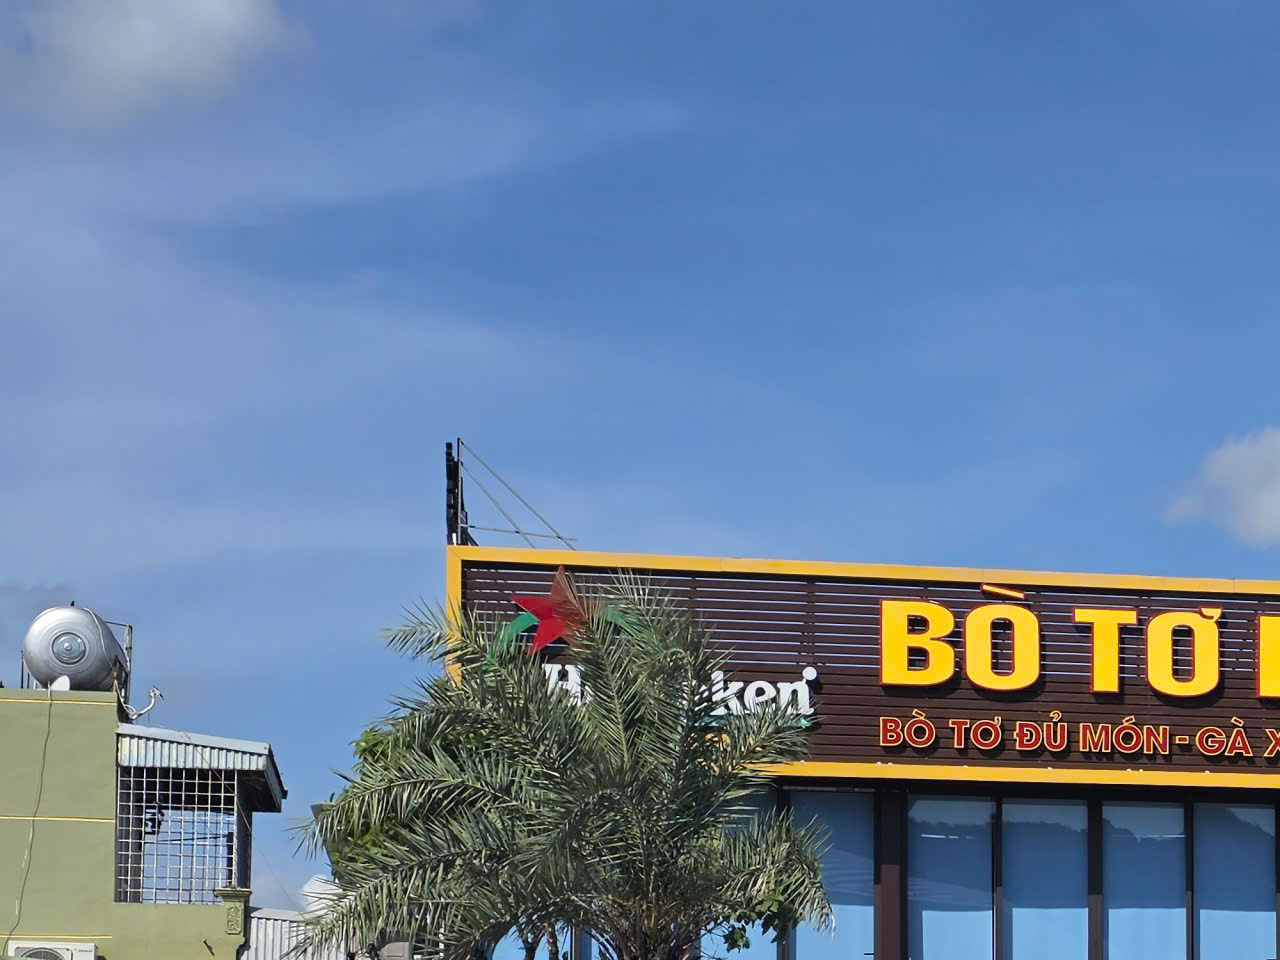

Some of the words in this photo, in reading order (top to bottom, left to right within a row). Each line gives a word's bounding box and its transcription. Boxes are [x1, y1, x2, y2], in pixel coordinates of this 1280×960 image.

[879, 583, 1041, 692] BÒ
[1071, 606, 1224, 699] TƠ
[879, 709, 936, 748] BÒ
[949, 715, 1002, 750] TƠ
[1013, 710, 1068, 752] ĐỦ
[1079, 715, 1170, 755] MÓN
[1195, 716, 1253, 758] GÀ
